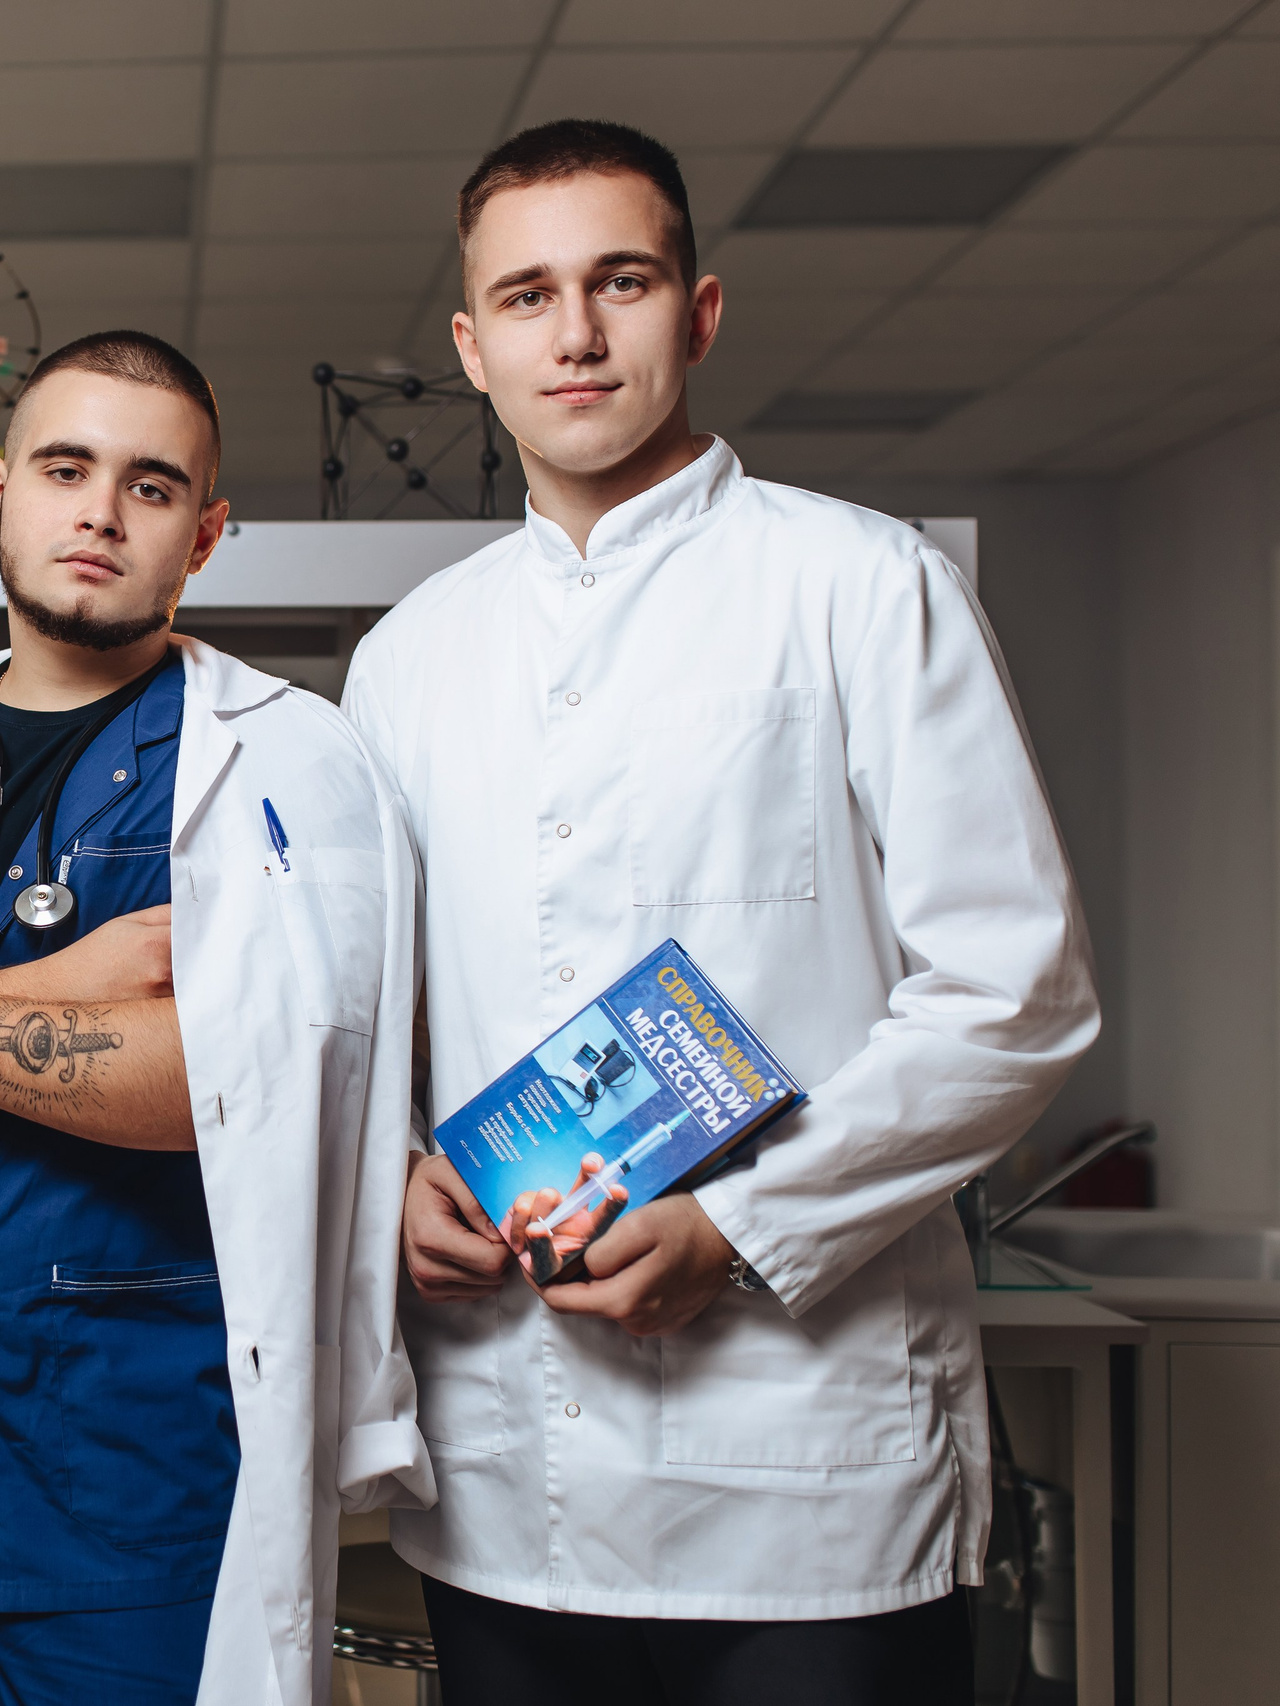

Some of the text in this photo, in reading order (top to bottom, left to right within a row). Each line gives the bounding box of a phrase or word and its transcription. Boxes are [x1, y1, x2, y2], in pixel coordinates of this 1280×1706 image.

[657, 966, 770, 1103] СПРАВОЧНИК
[625, 1007, 731, 1134] МЕДСЕСТРЫ
[658, 1009, 752, 1119] СЕМЕЙНОЙ
[529, 1084, 546, 1107] помощь
[535, 1079, 561, 1113] Неотложная
[495, 1112, 514, 1136] Лечение
[506, 1102, 523, 1124] Борьба
[524, 1127, 539, 1147] болью
